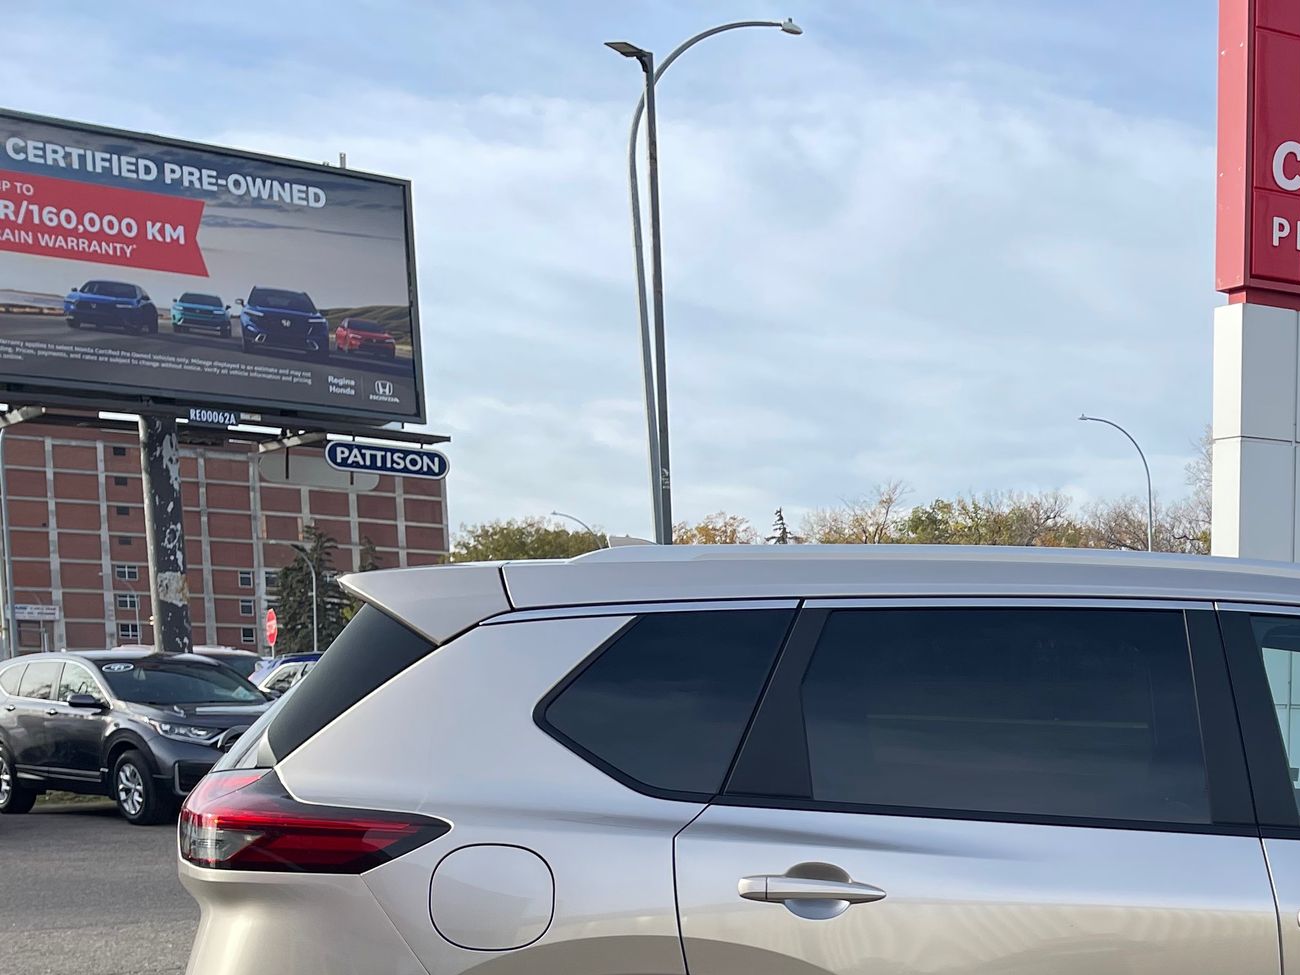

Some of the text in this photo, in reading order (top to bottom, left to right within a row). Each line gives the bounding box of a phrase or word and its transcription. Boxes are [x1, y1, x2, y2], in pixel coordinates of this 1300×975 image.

[5, 137, 327, 208] CERTIFIED PRE-OWNED
[0, 180, 34, 196] P TO
[0, 228, 33, 245] AIN
[146, 221, 185, 245] KM
[328, 375, 355, 387] Regina
[329, 385, 355, 396] Honda
[189, 408, 237, 425] RE00062A
[335, 446, 440, 474] PATTISON
